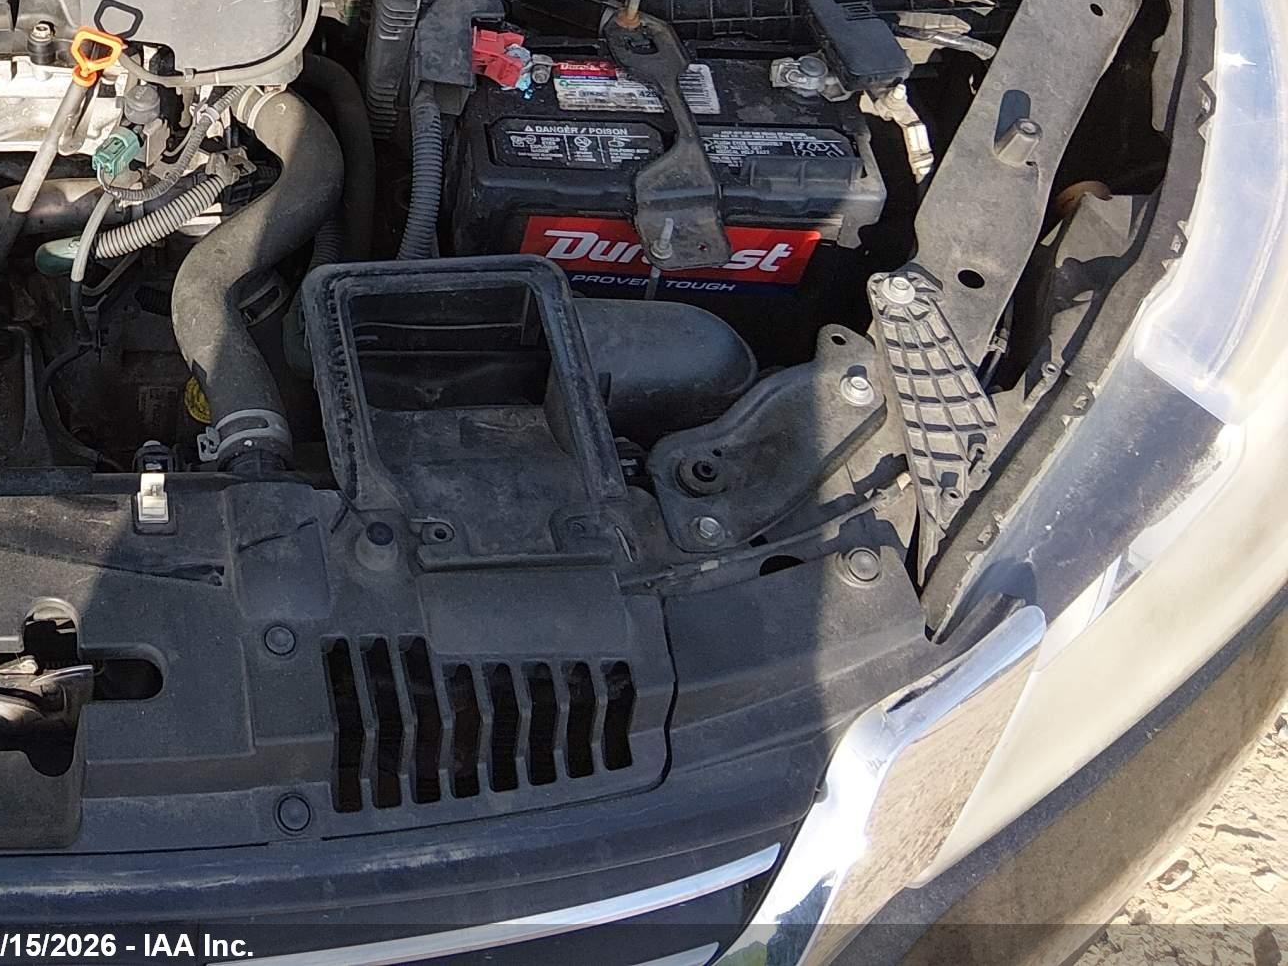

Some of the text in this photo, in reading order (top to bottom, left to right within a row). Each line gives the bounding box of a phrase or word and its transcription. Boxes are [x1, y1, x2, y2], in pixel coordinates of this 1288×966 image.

[535, 125, 578, 134] DANGER
[588, 127, 628, 135] POISON
[544, 229, 795, 272] Durst
[665, 280, 736, 291] TOUGH
